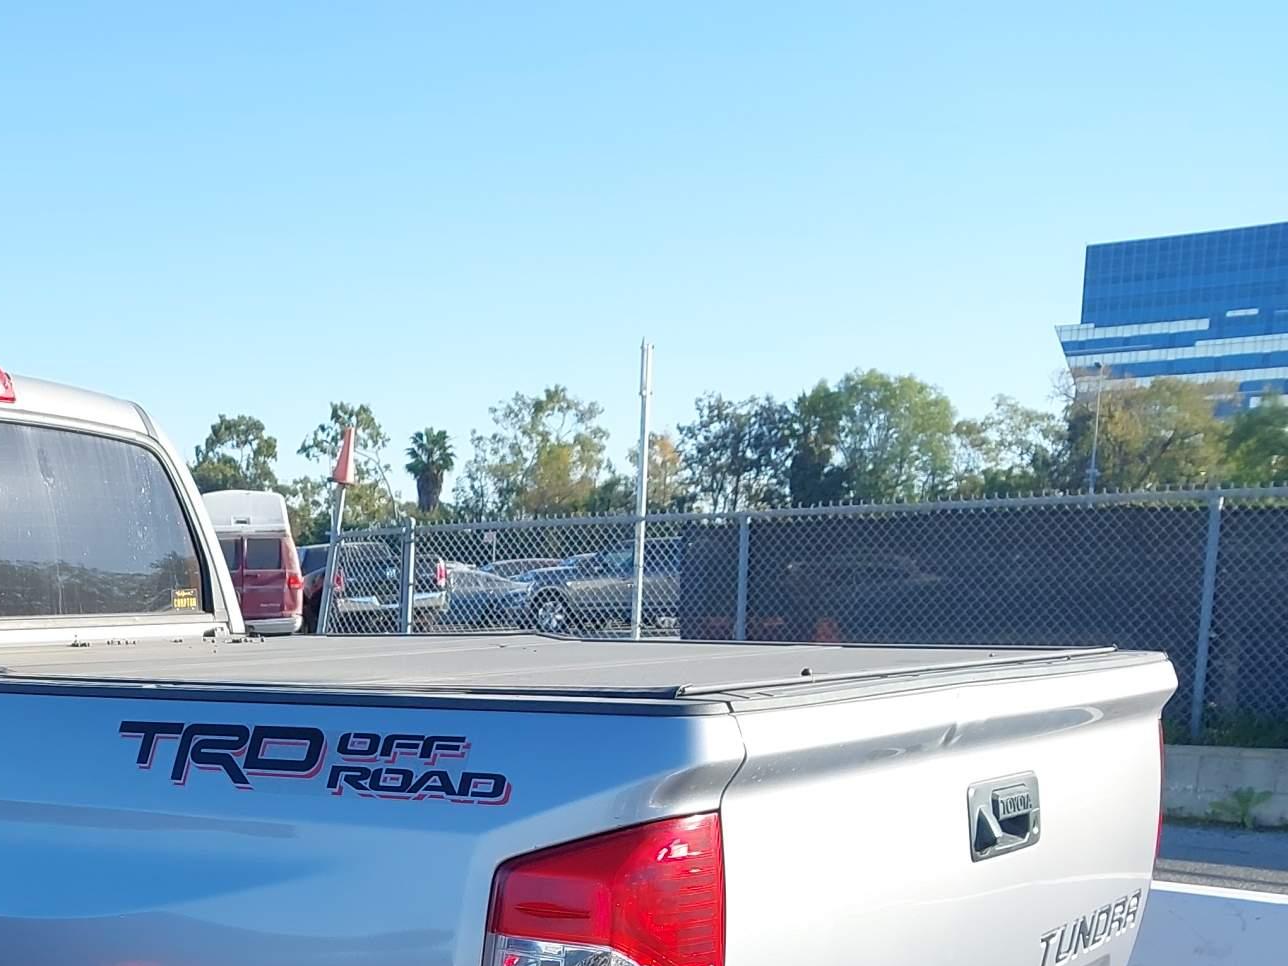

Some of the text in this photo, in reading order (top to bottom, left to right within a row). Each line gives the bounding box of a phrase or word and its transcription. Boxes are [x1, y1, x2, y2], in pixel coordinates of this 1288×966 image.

[118, 720, 327, 790] TRD
[335, 731, 472, 766] OFF
[325, 764, 512, 806] ROAD
